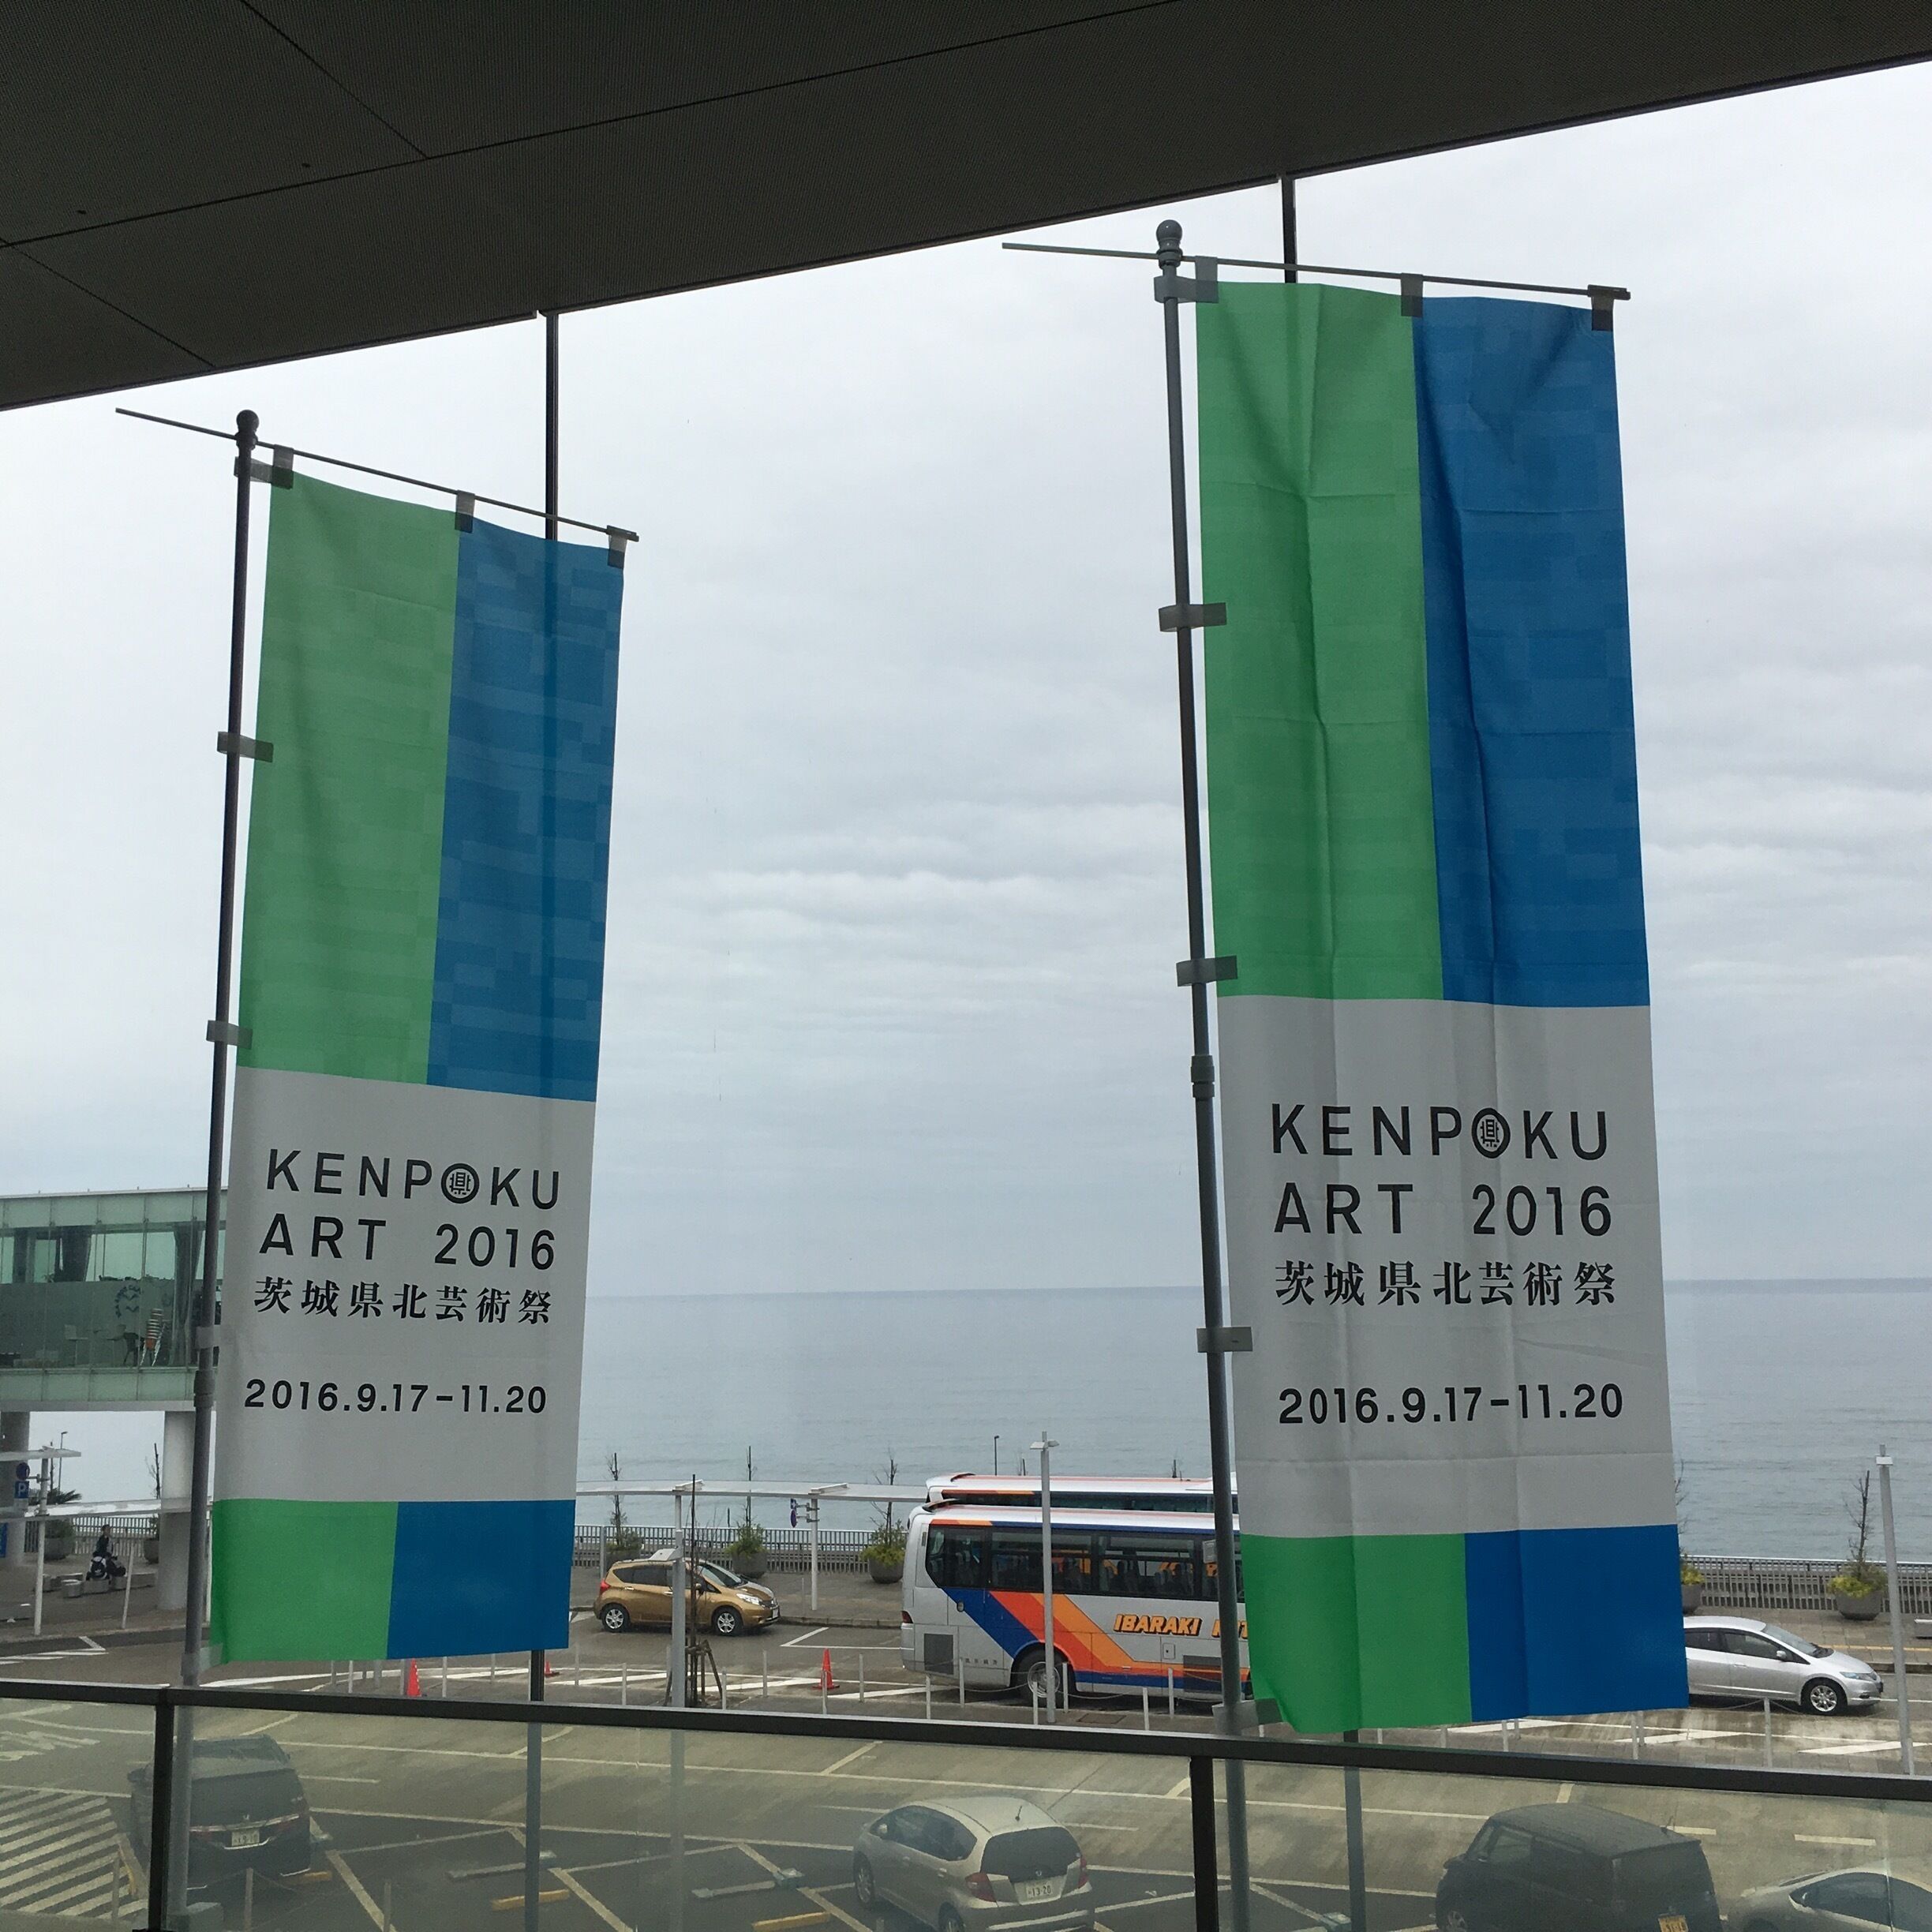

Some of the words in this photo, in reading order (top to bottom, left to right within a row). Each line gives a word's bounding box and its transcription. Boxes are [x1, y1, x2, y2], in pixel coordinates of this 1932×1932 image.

[1271, 1103, 1608, 1161] KENPOKU
[267, 1148, 559, 1210] KENPOKU
[1274, 1182, 1413, 1234] ART
[1472, 1184, 1612, 1237] 2016
[259, 1213, 387, 1260] ART
[434, 1223, 555, 1270] 2016
[254, 1276, 551, 1324] 茨城県北芸術祭
[1275, 1260, 1616, 1306] 茨城県北芸術祭
[244, 1379, 546, 1413] 2016.9.17-11.20
[1279, 1383, 1623, 1424] 2016.9.17-11.20
[18, 1482, 27, 1497] P
[1114, 1614, 1203, 1637] IBARAKI
